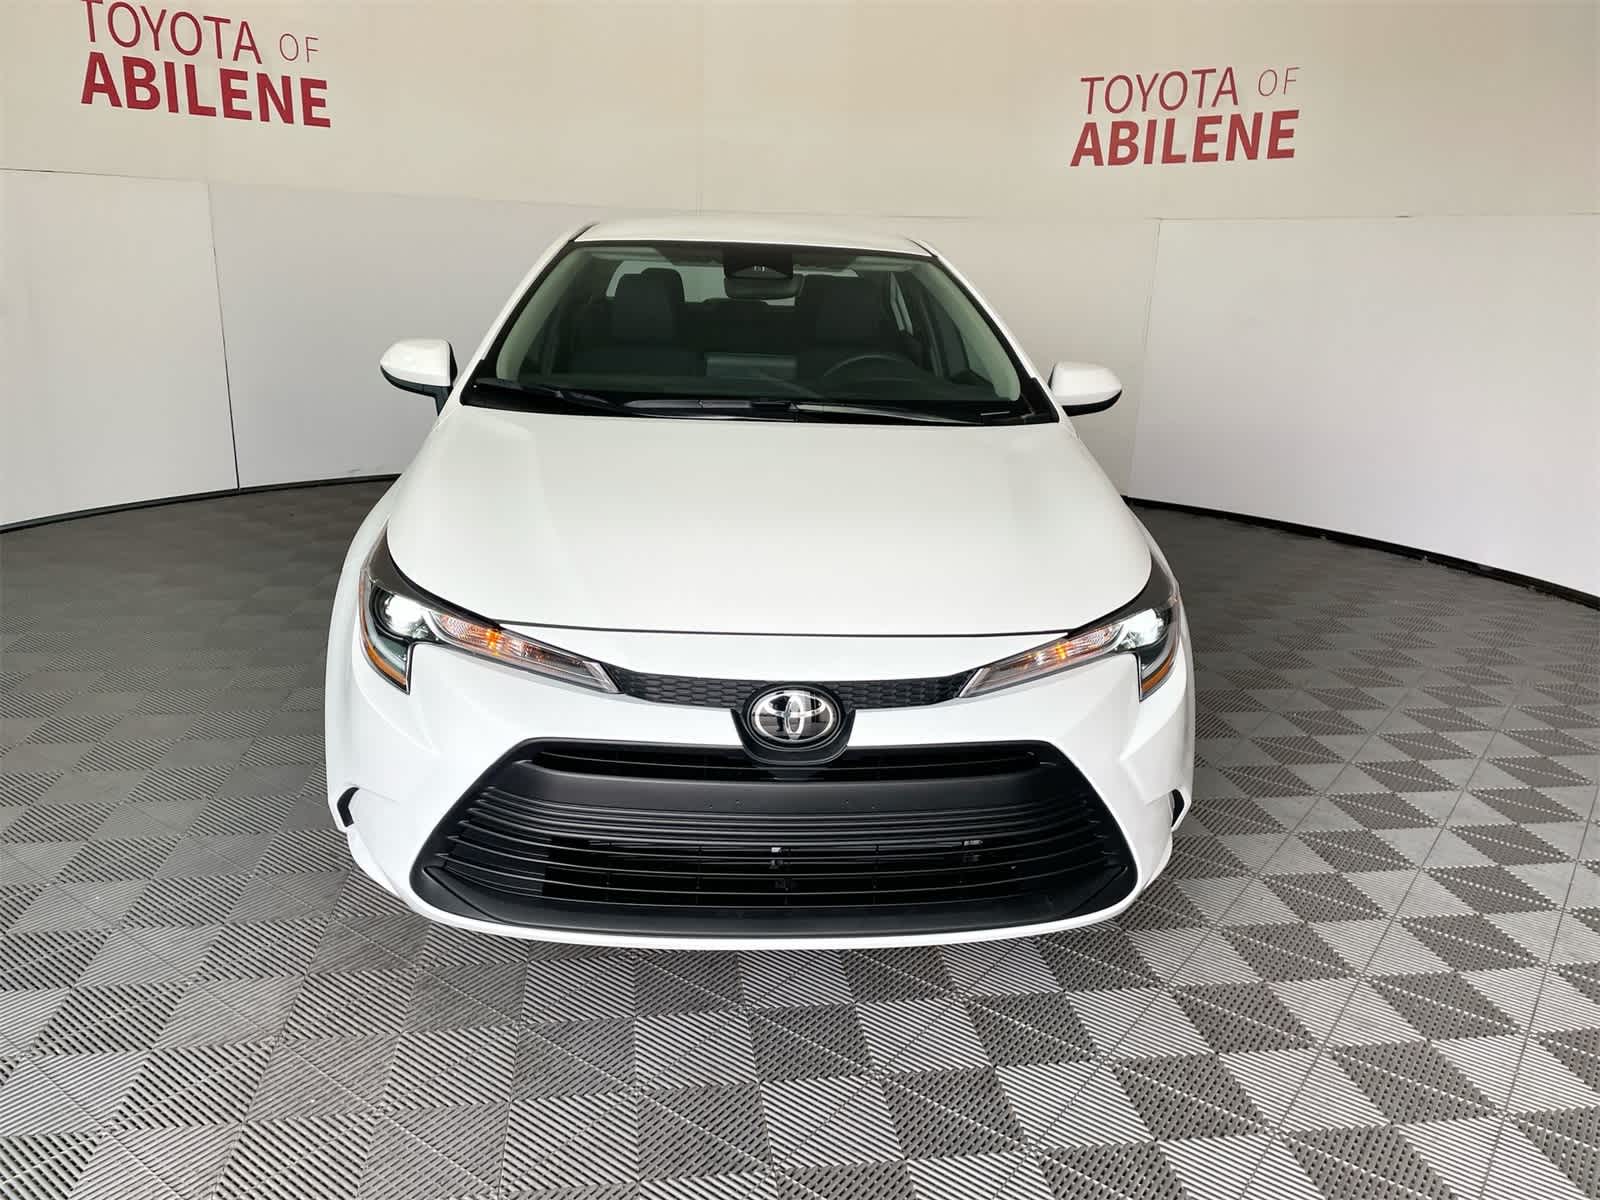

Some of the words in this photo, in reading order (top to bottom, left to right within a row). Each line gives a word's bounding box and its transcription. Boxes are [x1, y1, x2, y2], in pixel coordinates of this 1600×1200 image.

[82, 0, 262, 64] TOYOTA
[279, 33, 319, 63] OF
[81, 51, 331, 128] ABILENE
[1080, 66, 1239, 114] TOYOTA
[1258, 66, 1300, 97] OF
[1070, 109, 1300, 167] ABILENE
